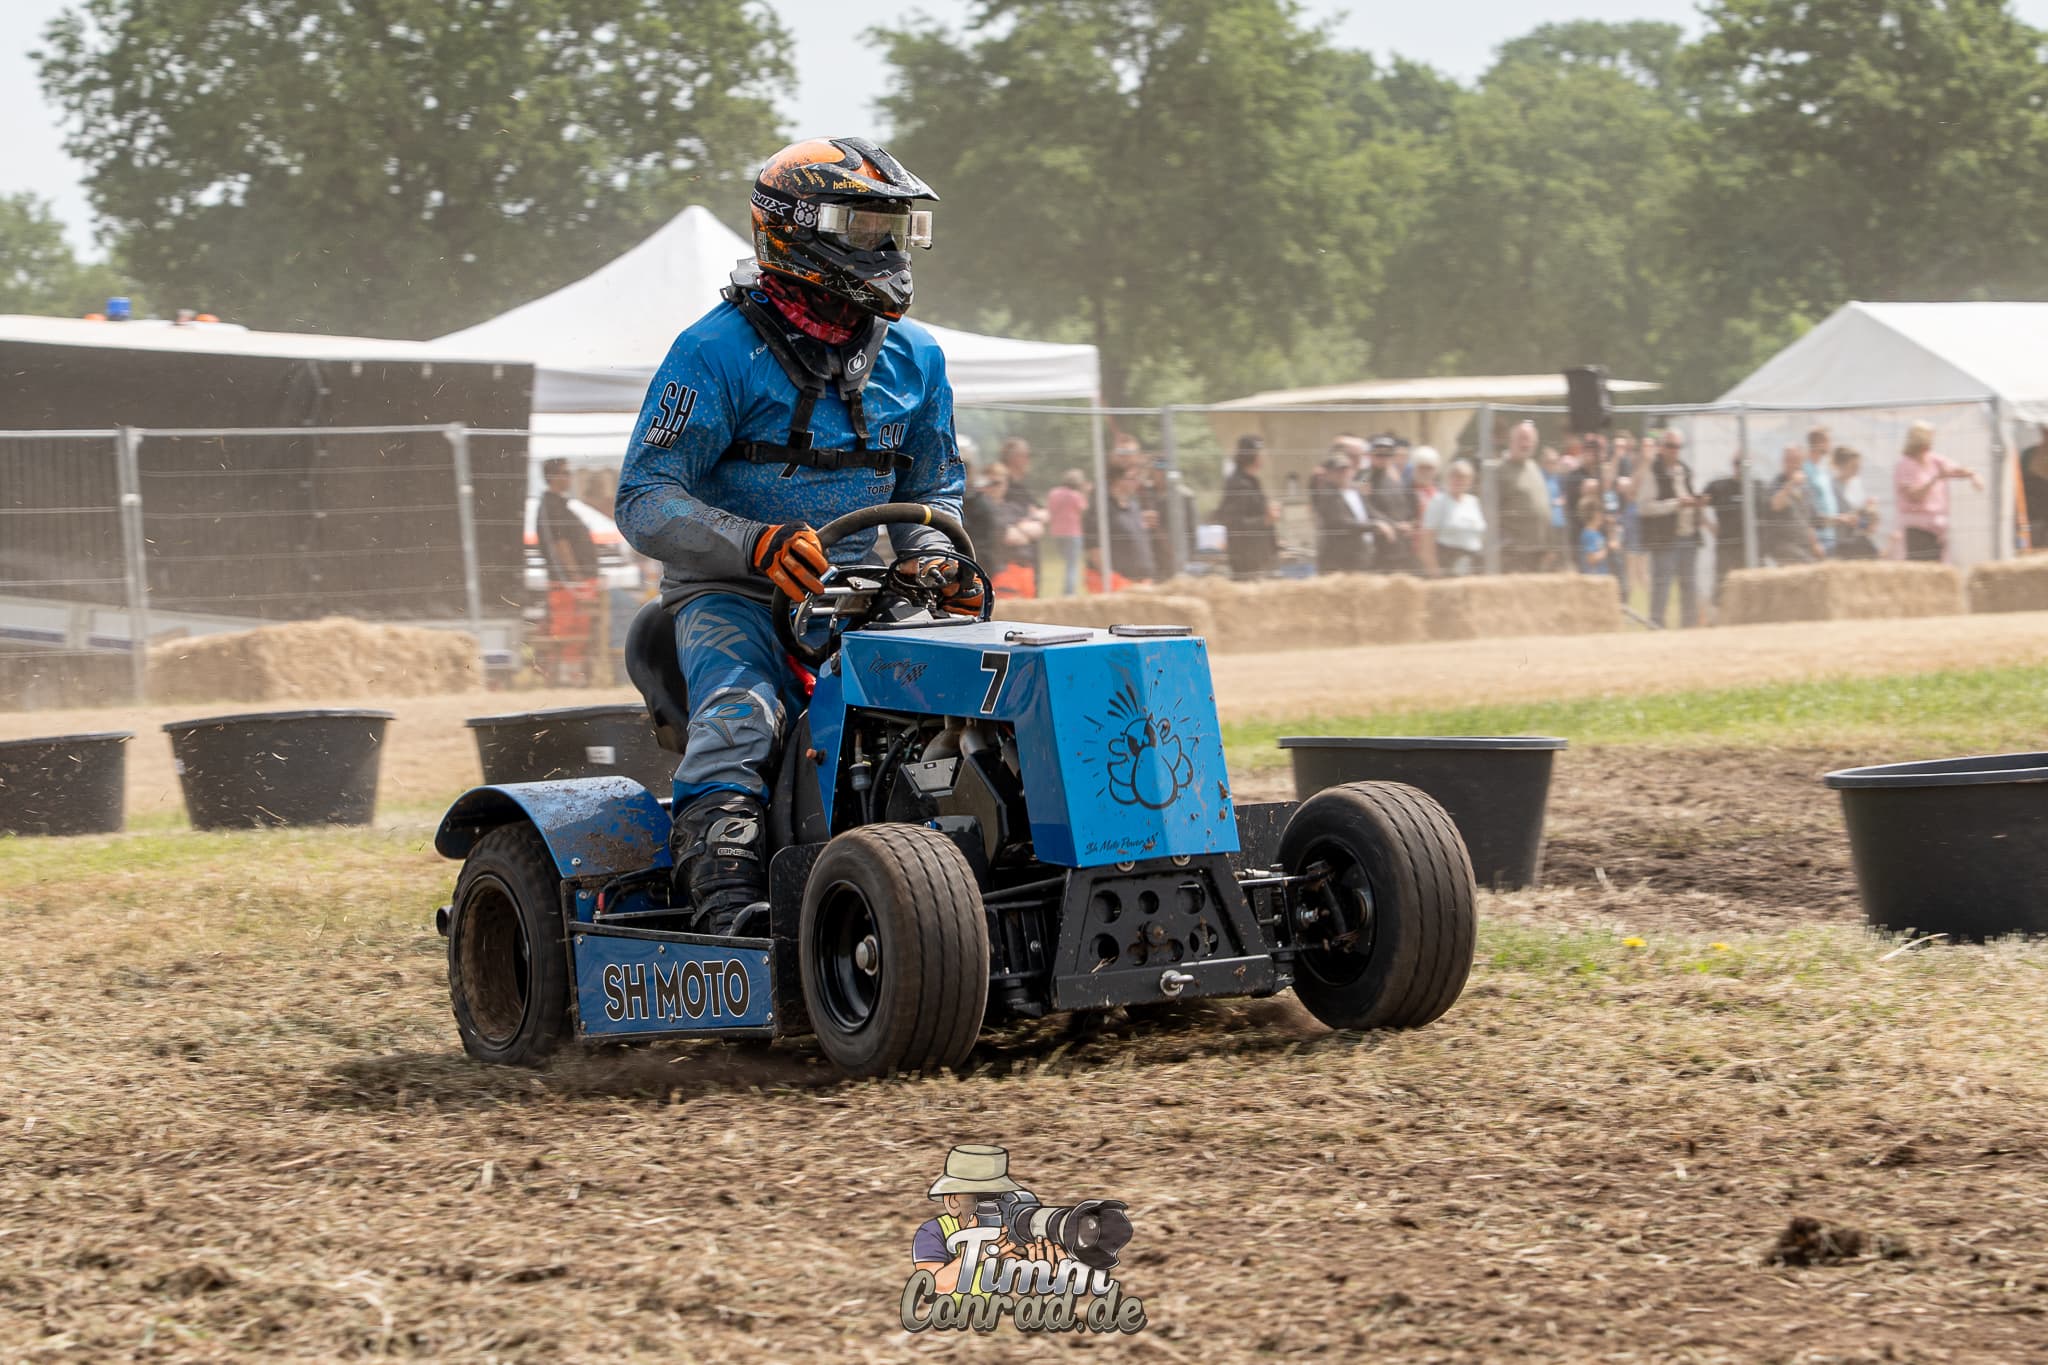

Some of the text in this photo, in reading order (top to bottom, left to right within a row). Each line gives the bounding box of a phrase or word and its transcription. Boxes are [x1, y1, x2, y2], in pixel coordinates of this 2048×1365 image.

[652, 381, 698, 432] SH
[645, 427, 679, 447] MOTO
[980, 650, 1011, 714] 7
[603, 958, 750, 1022] SH MOTO
